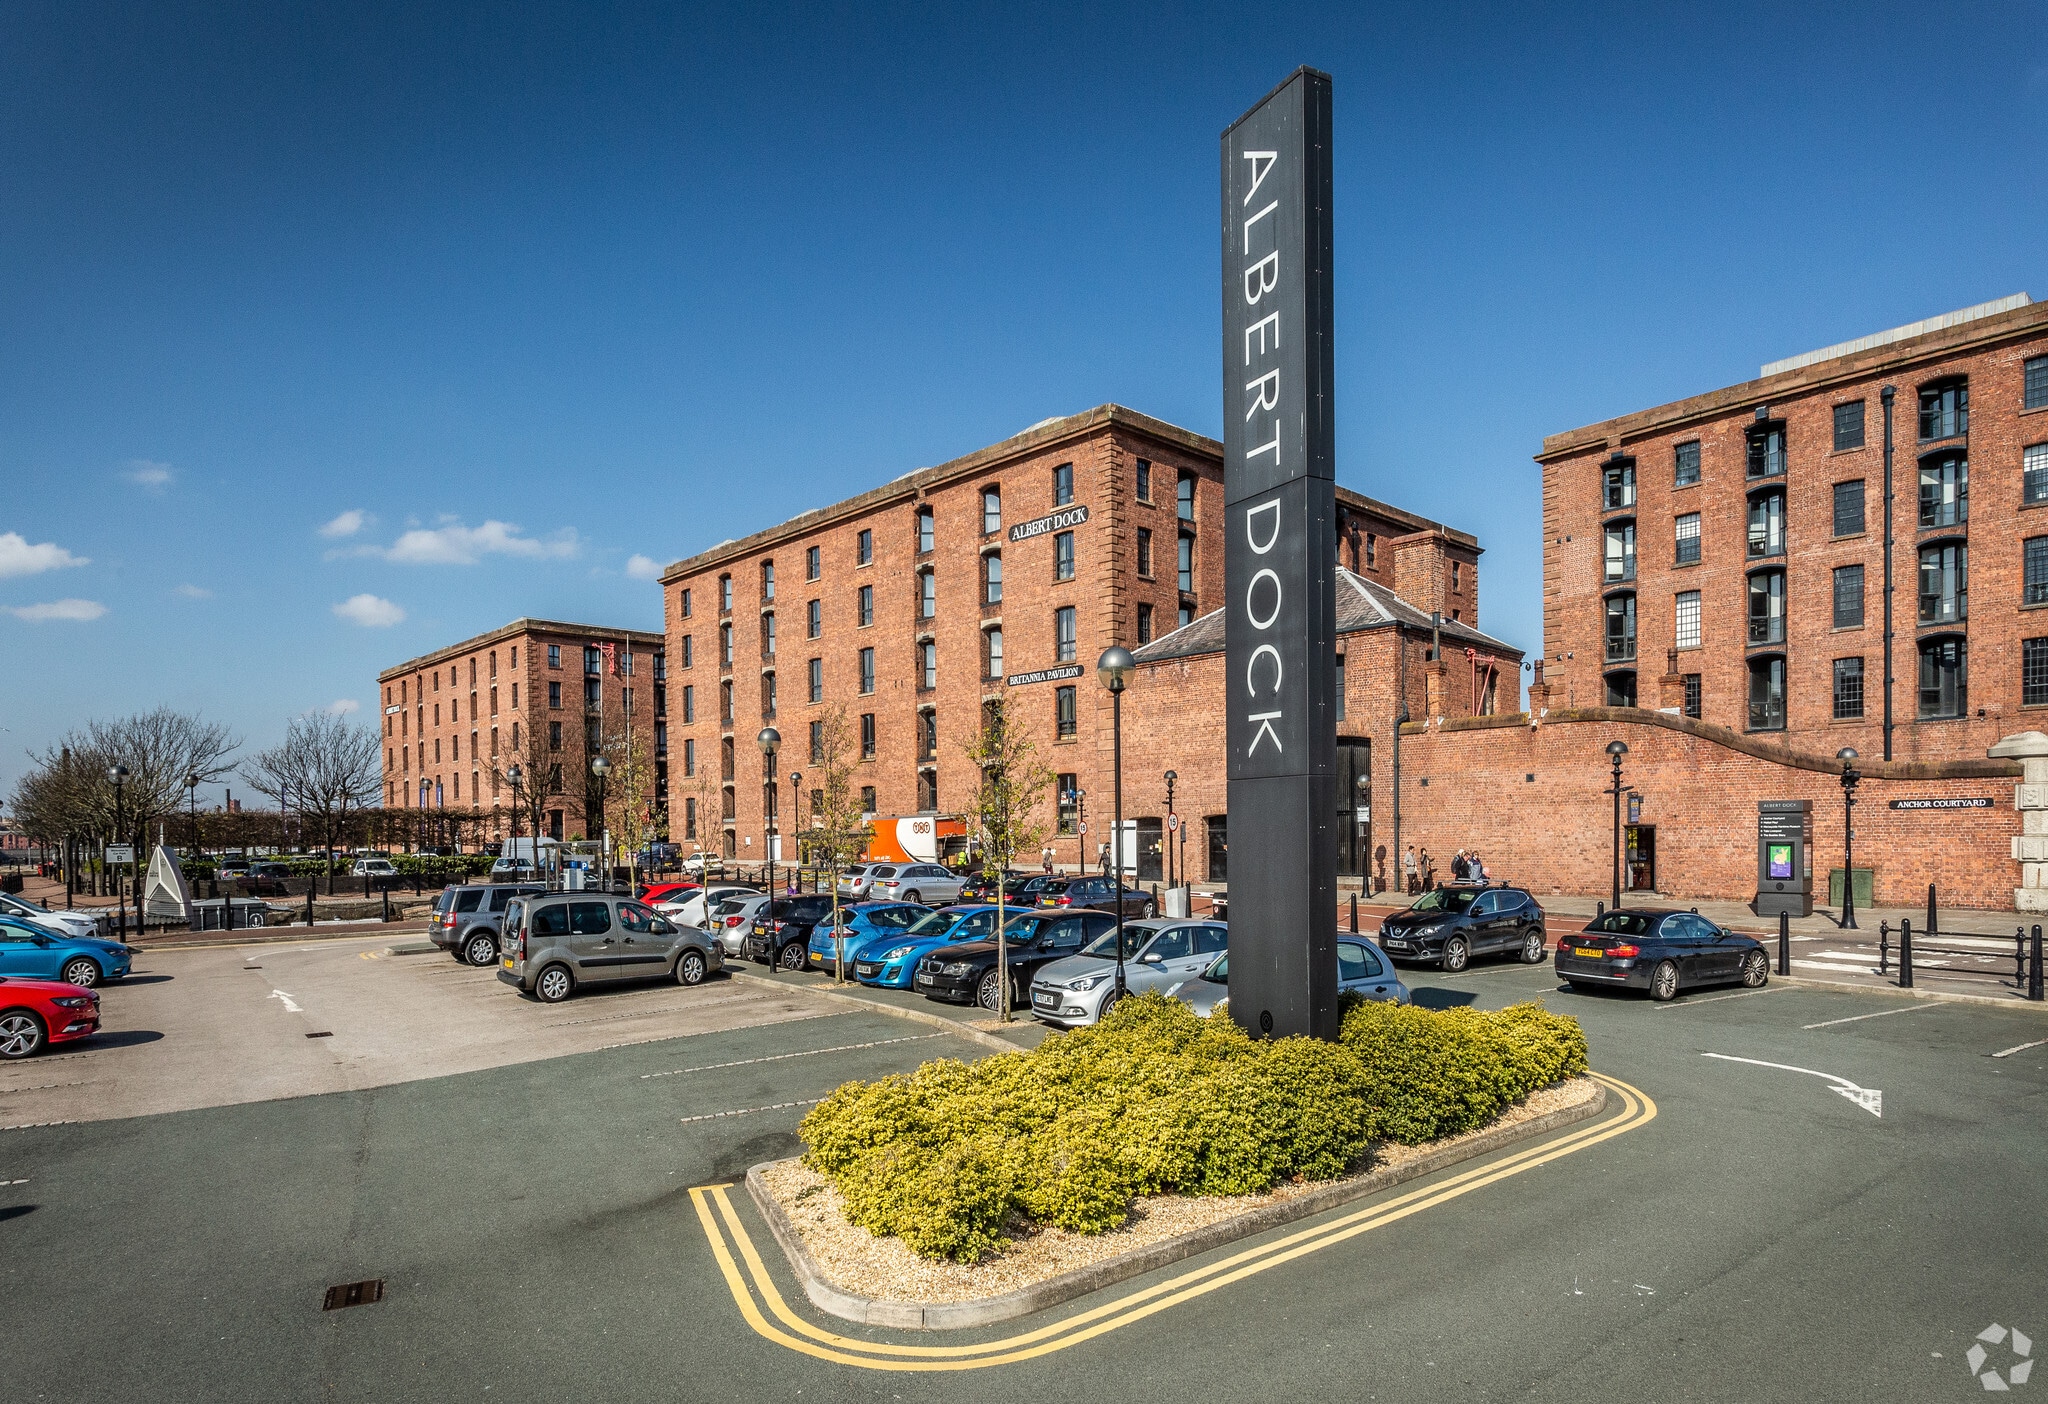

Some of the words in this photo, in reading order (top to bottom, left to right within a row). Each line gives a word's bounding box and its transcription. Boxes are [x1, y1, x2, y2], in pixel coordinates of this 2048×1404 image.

[1243, 151, 1280, 466] ALBERT
[1011, 517, 1052, 540] ALBERT
[1053, 507, 1086, 529] DOCK
[1246, 498, 1282, 758] DOCK
[1009, 671, 1045, 685] BRITANNIA
[1046, 667, 1079, 681] PAVILION
[1933, 799, 1986, 808] COURTYARD
[913, 822, 930, 833] TNT
[1170, 818, 1176, 826] 15
